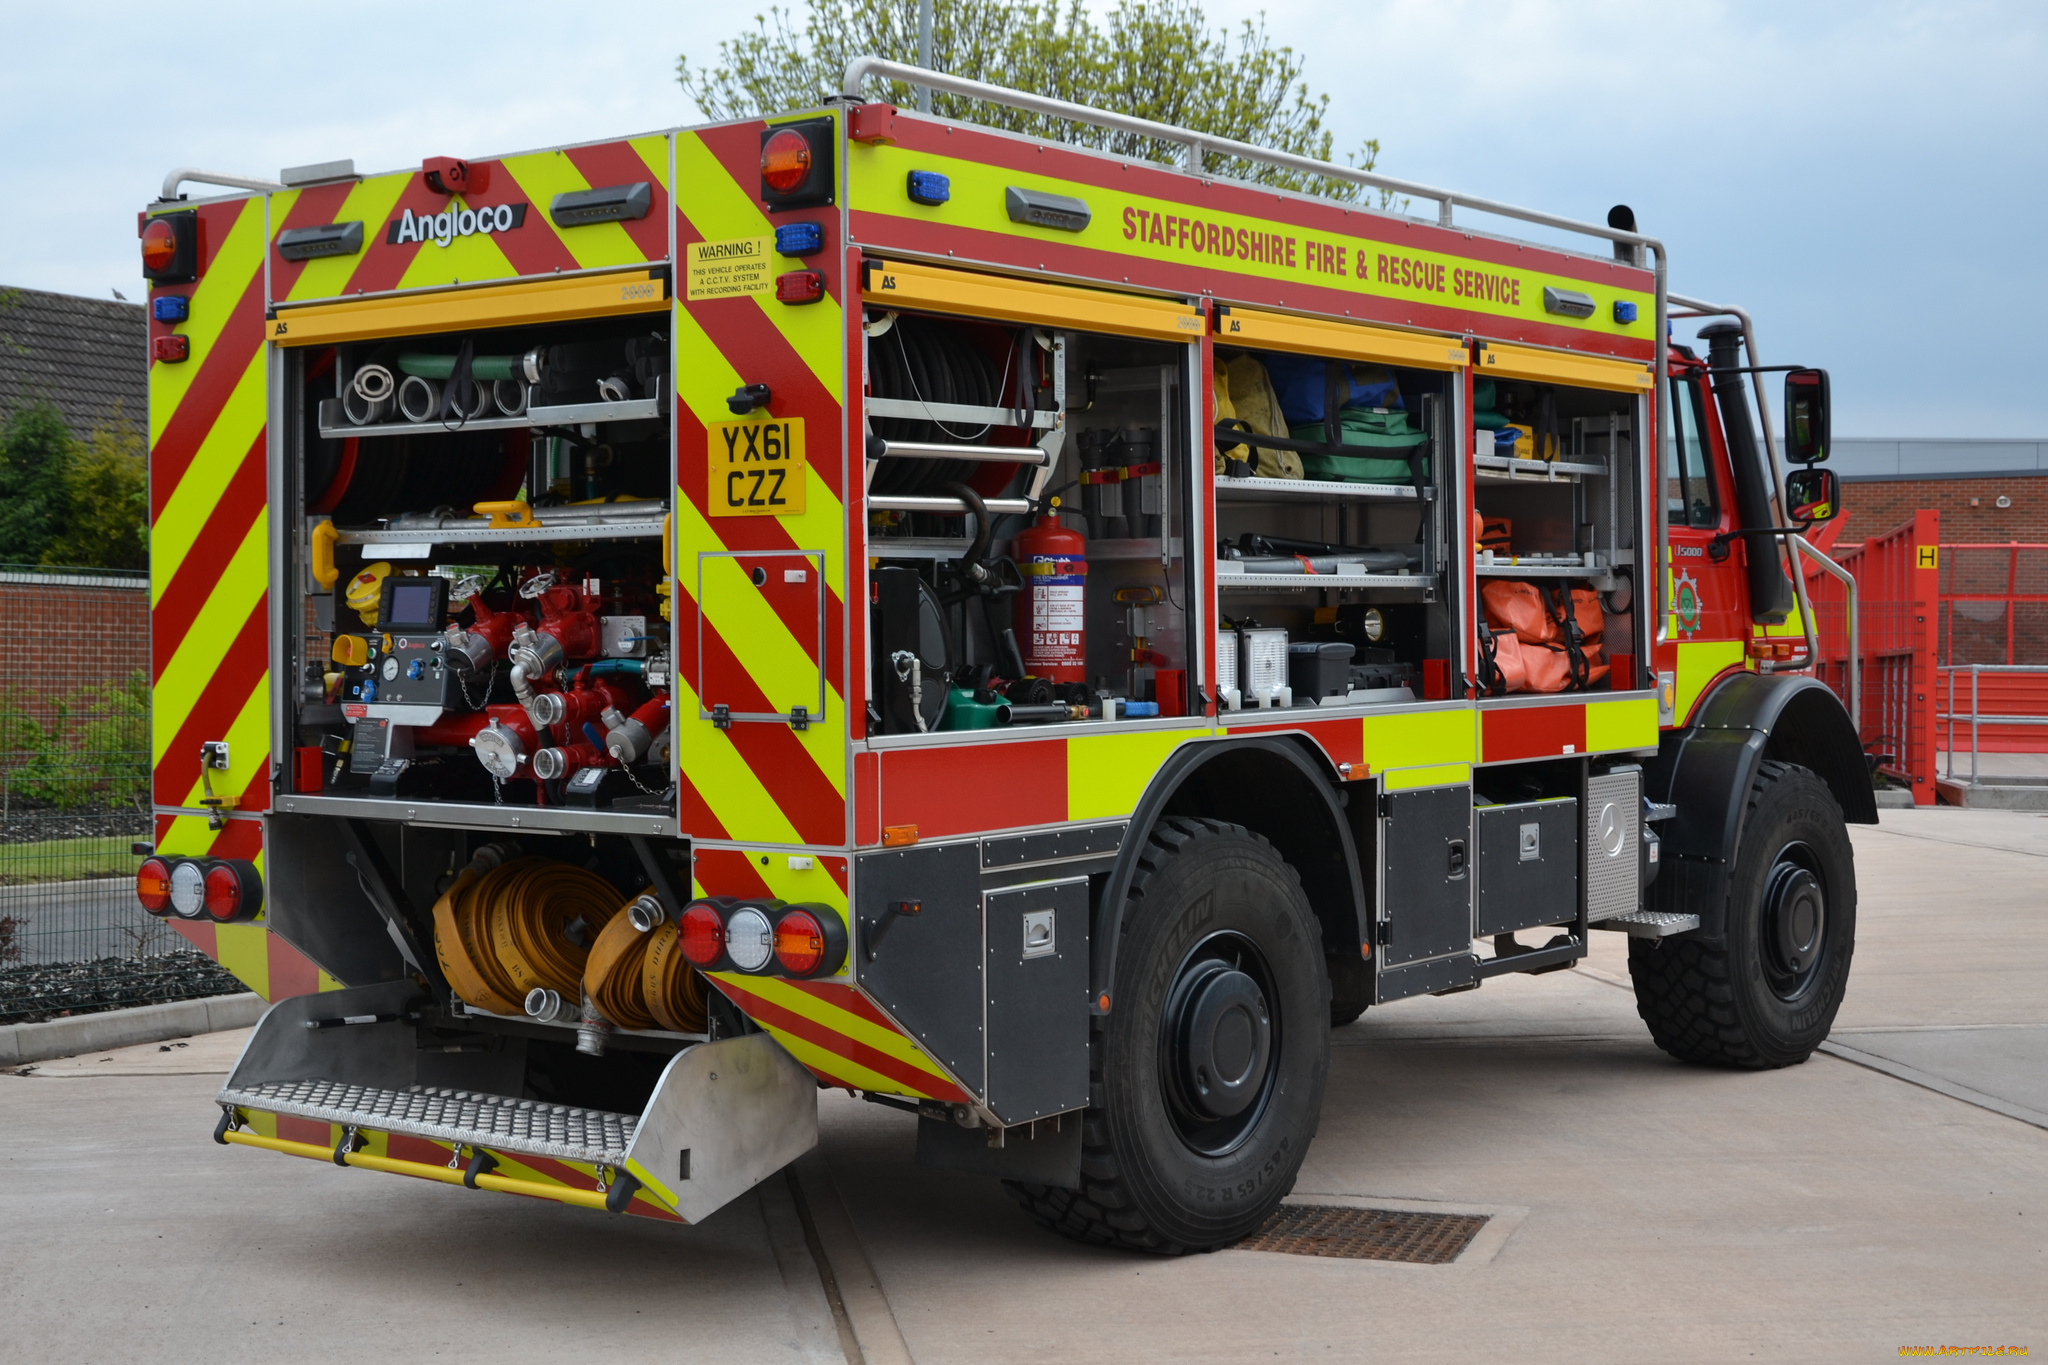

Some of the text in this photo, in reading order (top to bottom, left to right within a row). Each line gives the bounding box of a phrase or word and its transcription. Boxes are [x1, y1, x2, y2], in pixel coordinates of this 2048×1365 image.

[397, 202, 513, 248] Angloco
[698, 241, 753, 259] WARNING
[1122, 206, 1520, 306] STAFFORDSHIRE FIRE & RESCUE SERVICE
[693, 262, 766, 276] THIS VEHICLE OPERATES
[706, 276, 731, 285] C.C.T.V.
[733, 273, 760, 283] SYSTEM
[621, 283, 655, 300] 2000
[690, 282, 769, 296] WITH RECORDING FACILITY
[1177, 316, 1200, 331] 2000
[722, 423, 790, 463] YX61
[727, 468, 786, 507] CZZ
[1674, 544, 1703, 557] U5000
[1920, 547, 1935, 566] H
[1142, 893, 1212, 1058] MICHELIN
